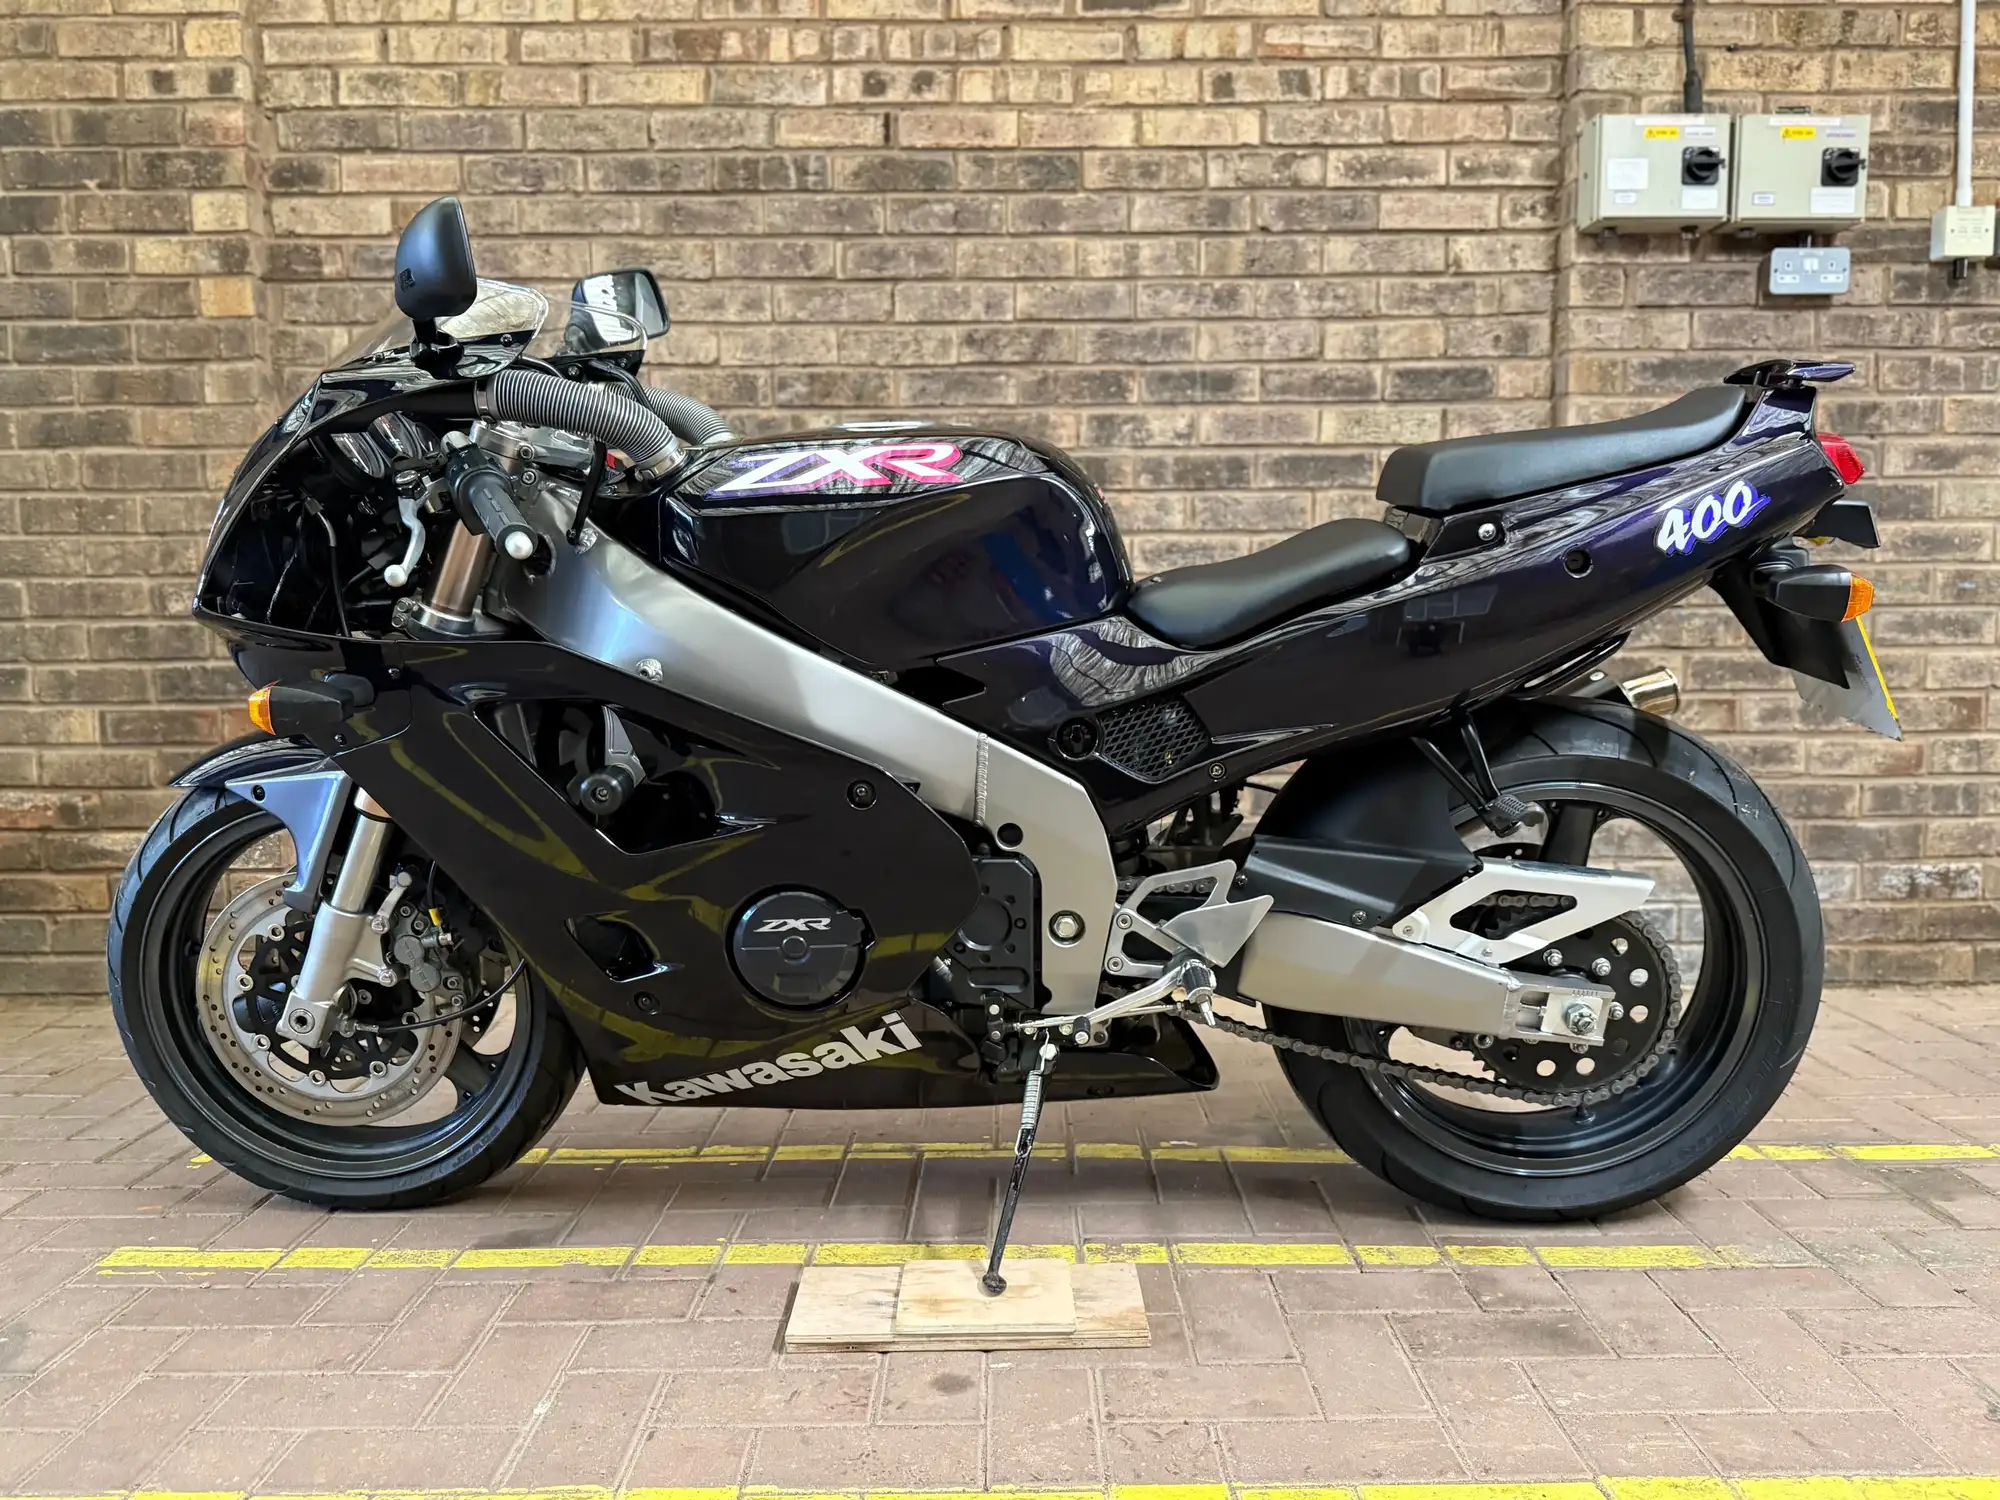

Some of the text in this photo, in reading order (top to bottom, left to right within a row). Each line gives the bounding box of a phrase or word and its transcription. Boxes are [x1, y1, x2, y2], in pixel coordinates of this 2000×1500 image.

[706, 442, 963, 499] ZXR
[1656, 480, 1769, 553] 400
[753, 917, 832, 933] ZXR
[613, 1010, 923, 1106] Kawasaki
